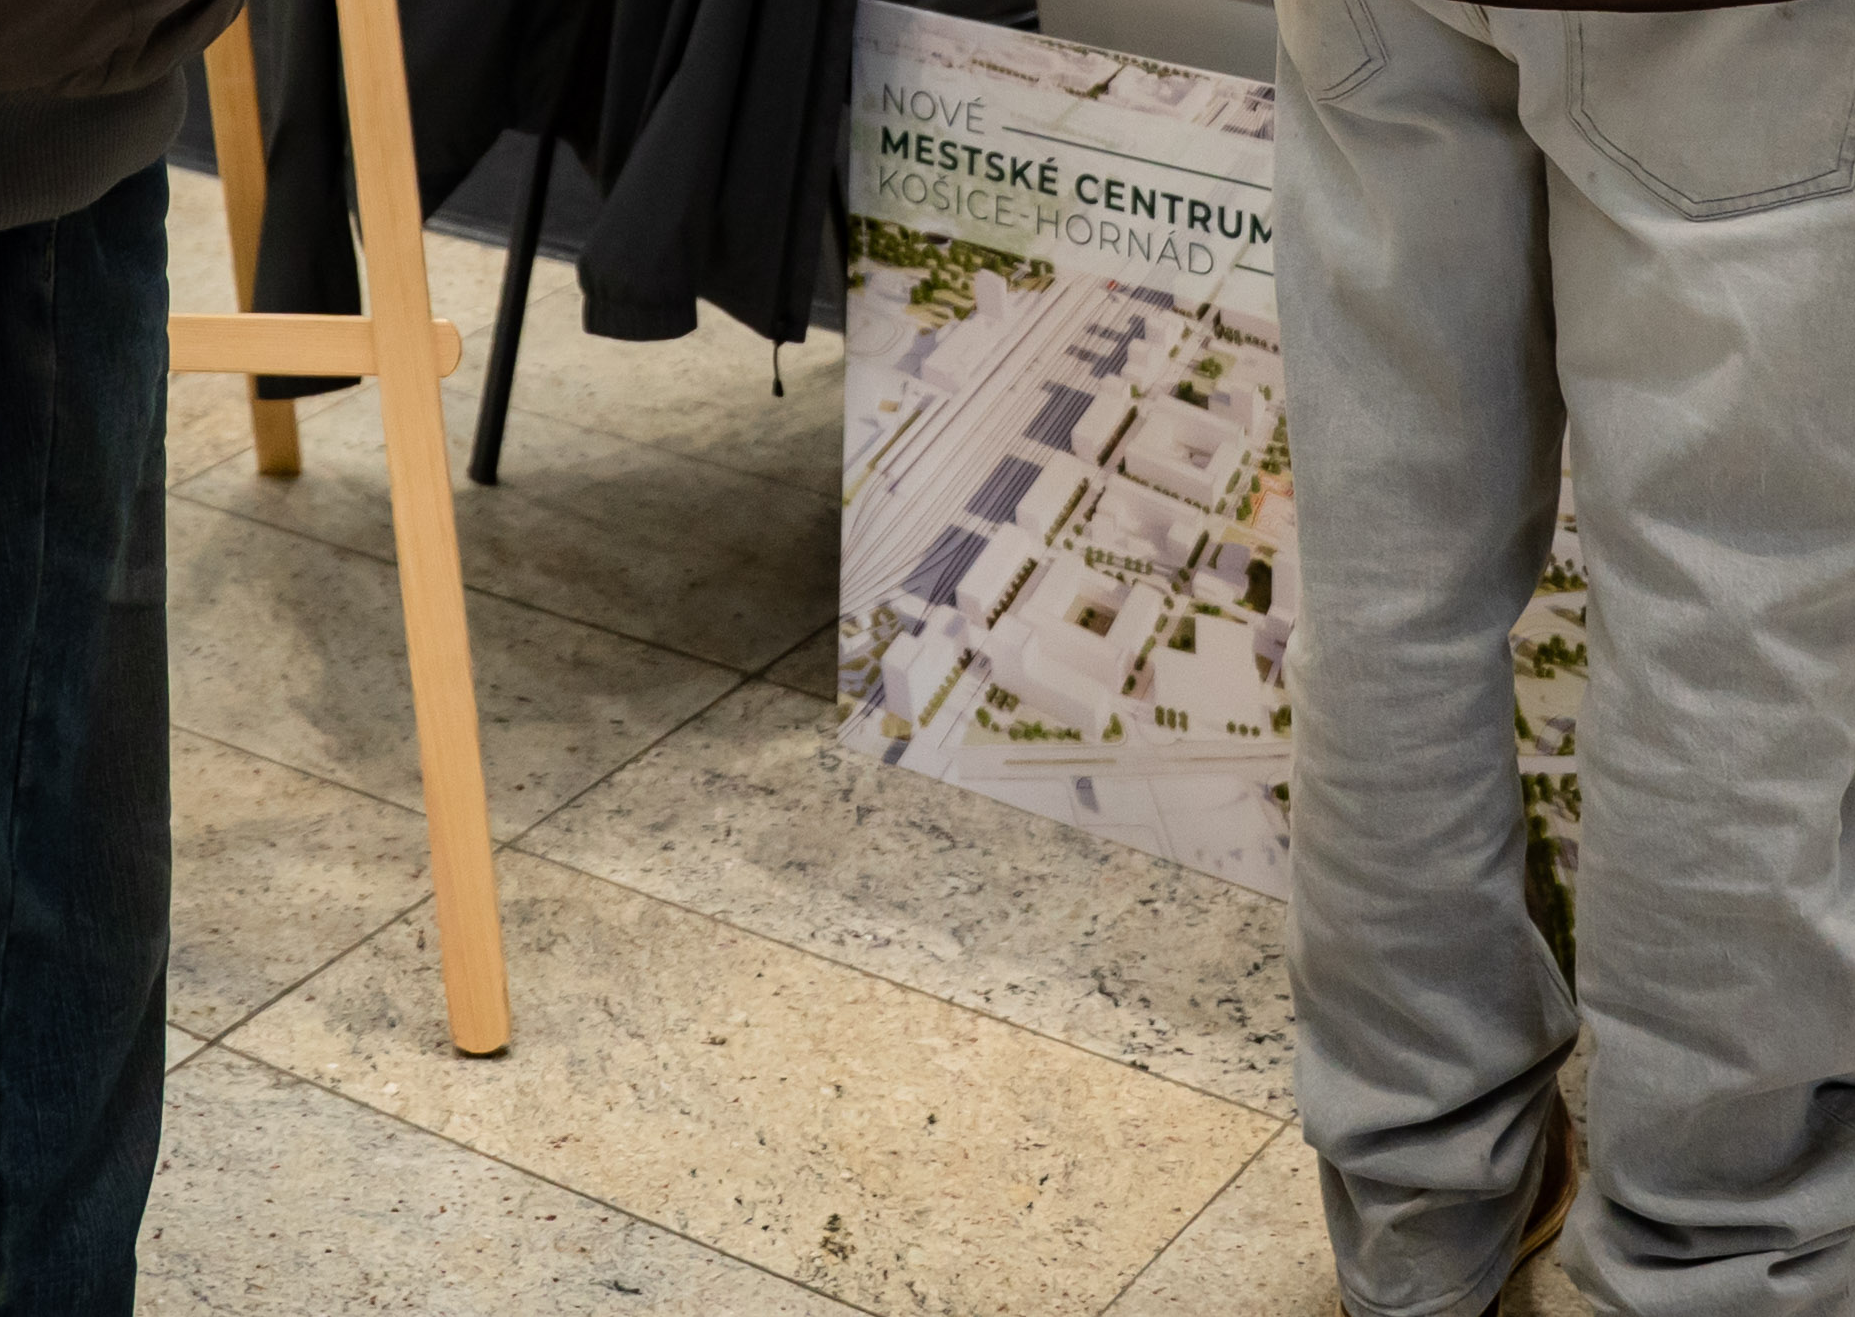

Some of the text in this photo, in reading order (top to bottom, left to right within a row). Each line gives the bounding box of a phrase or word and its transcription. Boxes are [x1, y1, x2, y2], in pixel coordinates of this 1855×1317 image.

[881, 82, 987, 135] NOVÉ
[877, 167, 1215, 276] KOŠICE-HORNÁD
[879, 125, 1273, 245] MESTSKÉ CENTRUM
